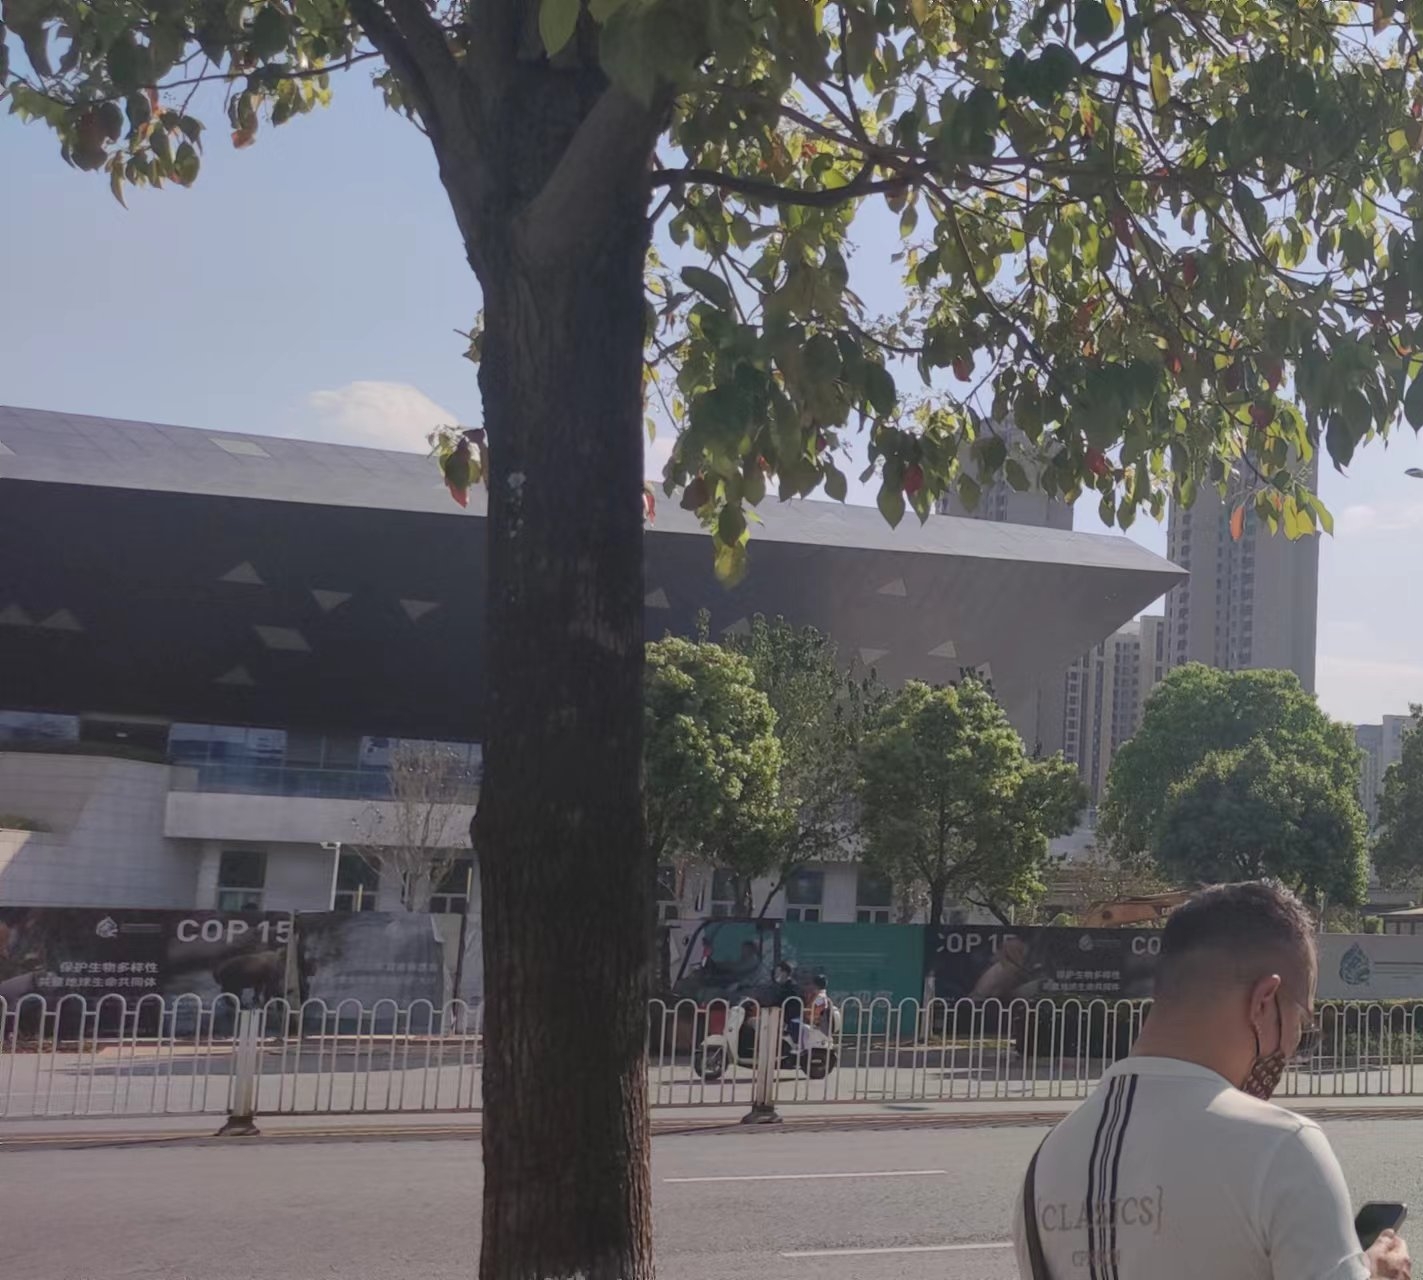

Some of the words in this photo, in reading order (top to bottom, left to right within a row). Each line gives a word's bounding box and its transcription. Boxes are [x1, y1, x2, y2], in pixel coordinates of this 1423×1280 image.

[177, 919, 249, 944] COP
[256, 920, 291, 944] 15
[59, 961, 159, 973] 保护生物多样性
